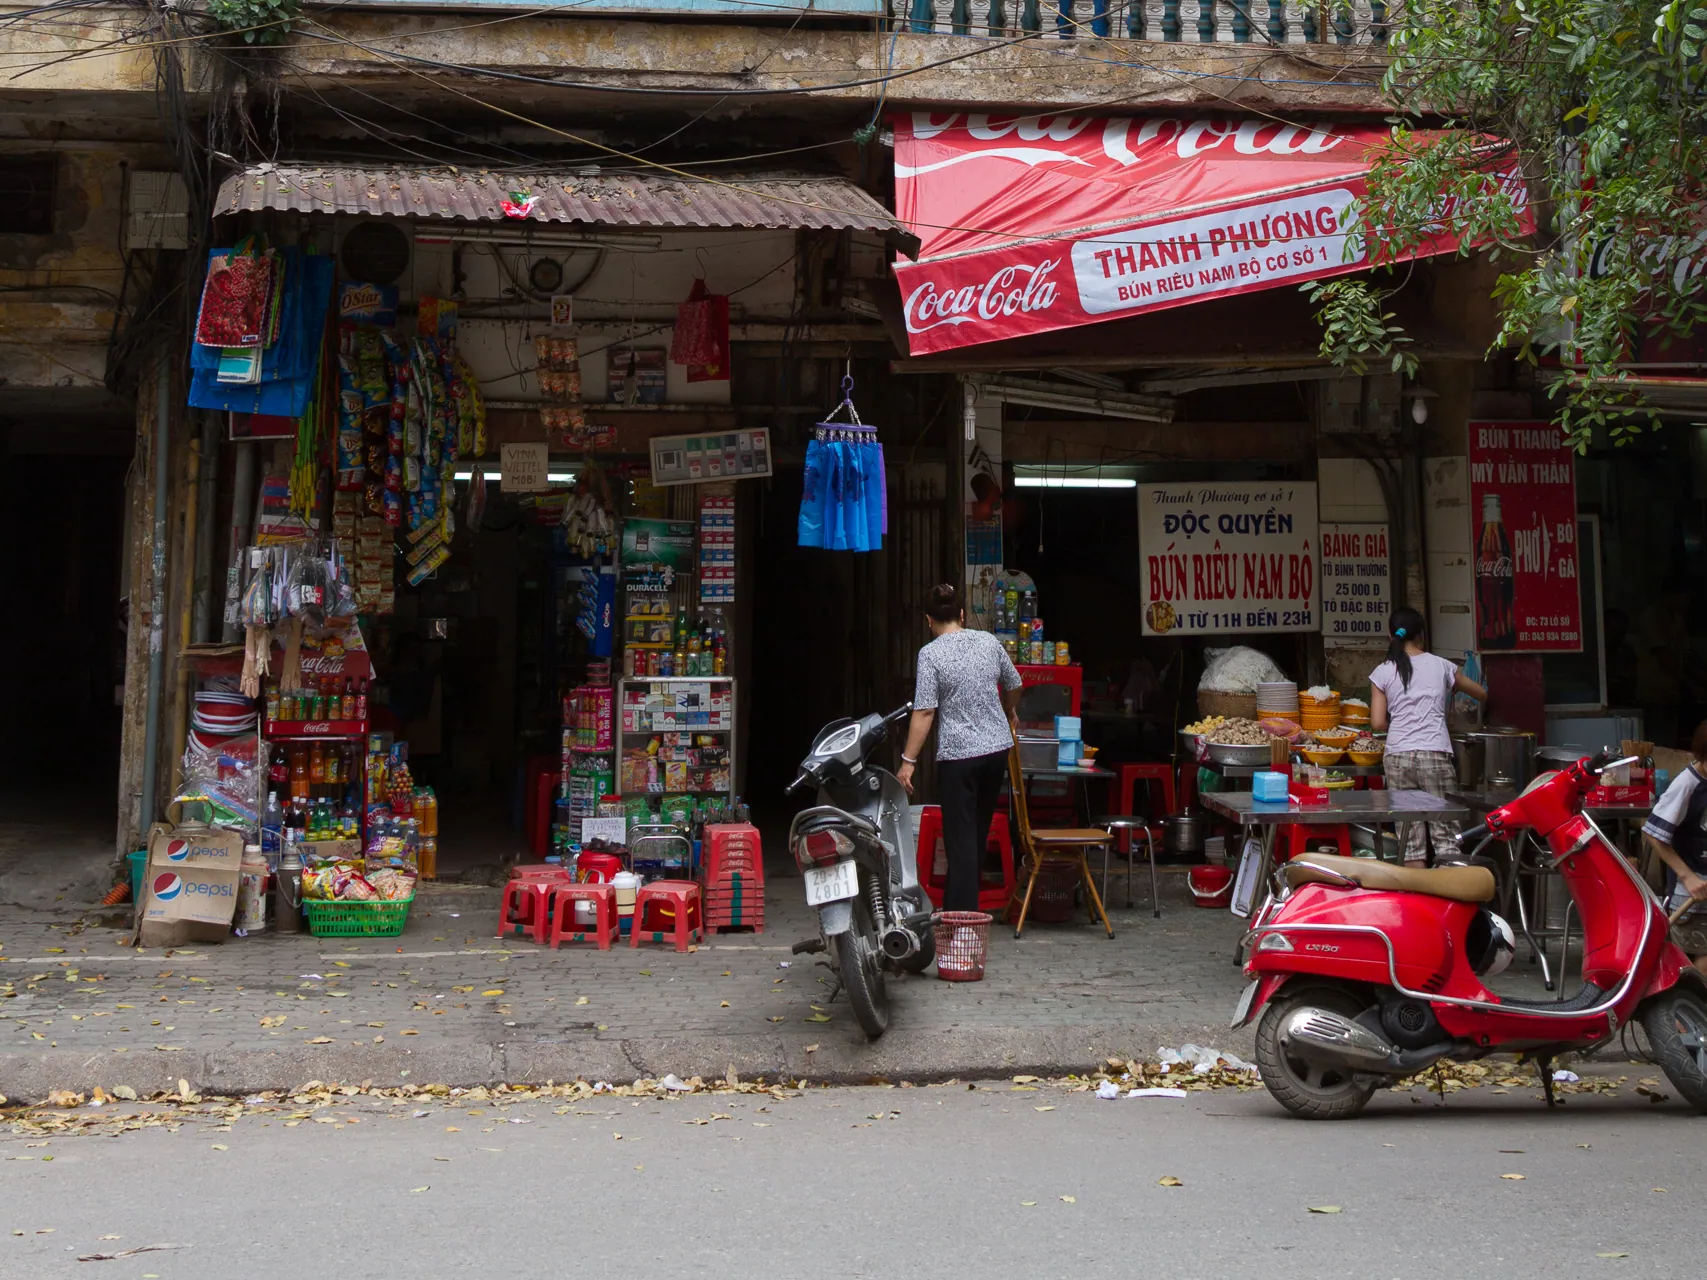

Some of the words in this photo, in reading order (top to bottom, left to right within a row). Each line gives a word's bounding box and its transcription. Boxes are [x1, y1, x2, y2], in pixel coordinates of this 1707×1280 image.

[1094, 233, 1207, 279] THANH
[1208, 205, 1338, 257] PHƯƠNG
[1117, 279, 1153, 302] BÚN
[1156, 271, 1195, 297] RIÊU
[1199, 265, 1236, 286] NAM
[1240, 258, 1261, 279] BỘ
[1266, 253, 1288, 272] CƠ
[1293, 244, 1315, 266] SỞ
[1319, 247, 1328, 261] 1
[903, 257, 1062, 334] Coca-Cola
[1477, 425, 1509, 450] BÚN
[1512, 428, 1562, 451] THANG
[1152, 489, 1194, 504] Thanh
[1198, 488, 1250, 505] Phương
[1287, 490, 1294, 502] 1
[1163, 509, 1211, 539] ĐỘC
[1217, 506, 1293, 536] QUYỀN
[1556, 517, 1574, 545] BÒ
[1323, 524, 1360, 558] BẢNG
[1364, 527, 1388, 558] GIÁ
[1513, 510, 1541, 574] PHỞ
[1147, 542, 1187, 601] BÚN
[1192, 538, 1238, 601] RIÊU
[1243, 553, 1284, 601] NAM
[1288, 538, 1313, 610] BỘ
[1557, 552, 1577, 579] GÀ
[626, 583, 669, 593] DURACELL
[1336, 582, 1349, 596] 25
[1351, 583, 1370, 596] 000
[1187, 610, 1209, 629] TỪ
[1212, 613, 1241, 628] 11H
[1246, 606, 1277, 627] ĐẾN
[1282, 611, 1312, 626] 23H
[1333, 620, 1348, 633] 30
[1350, 620, 1371, 633] 000
[191, 846, 229, 858] pepsi
[184, 882, 233, 898] pepsi
[815, 880, 850, 901] 4801
